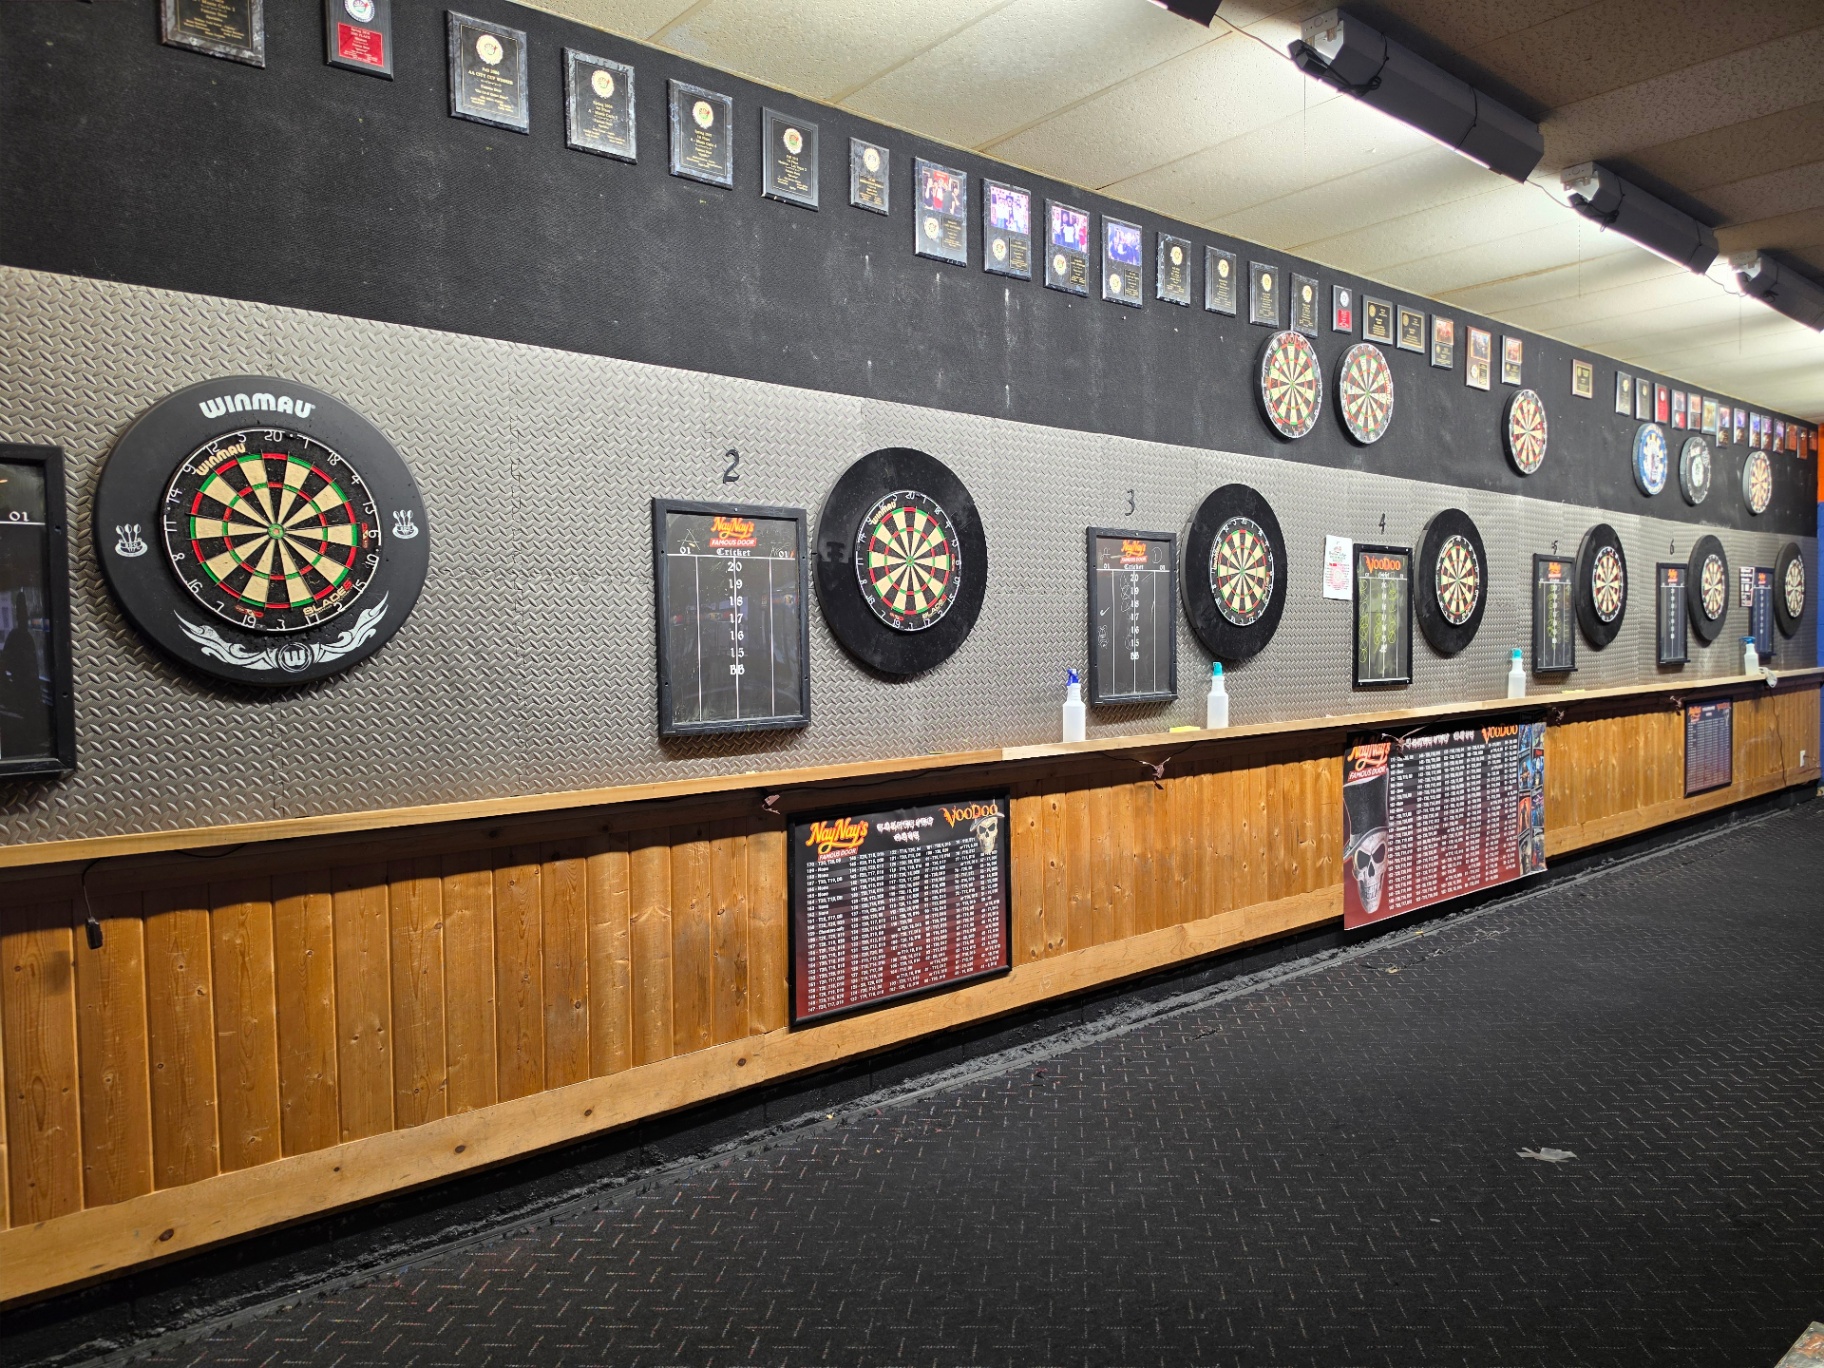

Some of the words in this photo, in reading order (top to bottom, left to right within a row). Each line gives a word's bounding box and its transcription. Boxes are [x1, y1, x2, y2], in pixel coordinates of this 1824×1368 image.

[199, 393, 313, 419] WINMAU
[264, 430, 282, 442] 20
[195, 443, 246, 476] WINMAU
[327, 451, 340, 466] 18
[723, 448, 740, 484] 2
[1124, 489, 1135, 517] 3
[710, 516, 755, 539] NayNay's
[1377, 512, 1386, 535] 4
[716, 548, 751, 556] Cricket
[727, 562, 742, 571] 20
[186, 579, 203, 594] 16
[729, 579, 743, 589] 19
[729, 596, 743, 606] 18
[730, 613, 743, 623] 17
[730, 631, 744, 640] 16
[730, 648, 744, 658] 15
[806, 817, 869, 854] NayNay's
